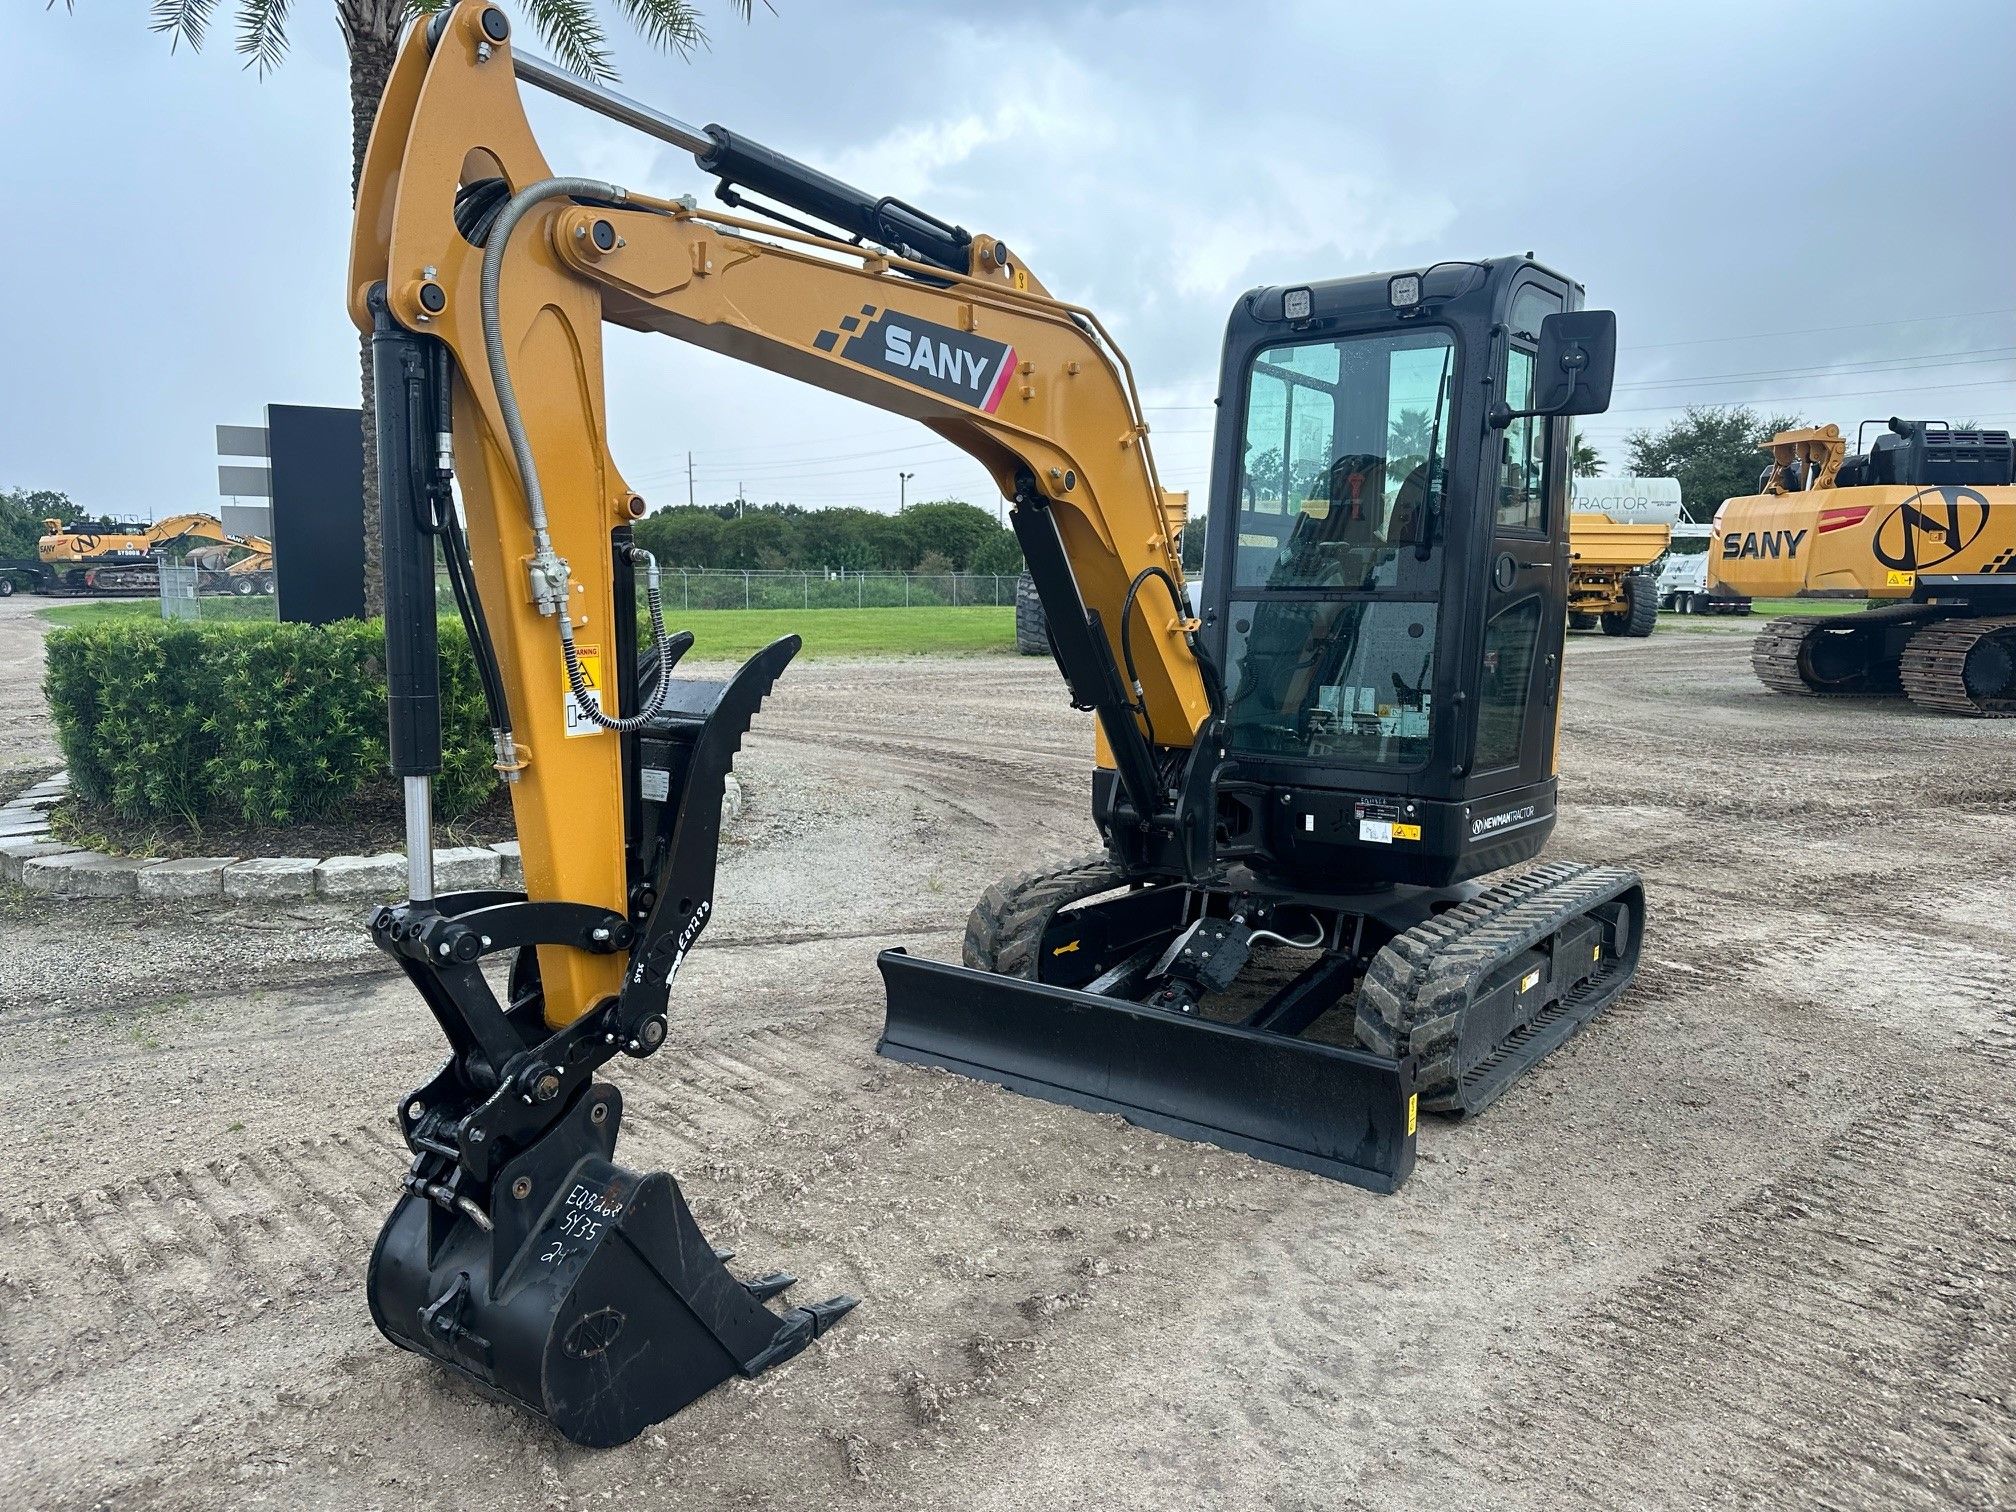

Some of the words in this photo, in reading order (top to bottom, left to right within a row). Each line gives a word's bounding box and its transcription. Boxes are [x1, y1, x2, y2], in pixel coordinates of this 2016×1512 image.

[885, 324, 989, 391] SANY
[40, 544, 56, 554] SANY
[1722, 529, 1808, 560] SANY
[576, 648, 597, 656] ARNING
[560, 1210, 602, 1241] SY35
